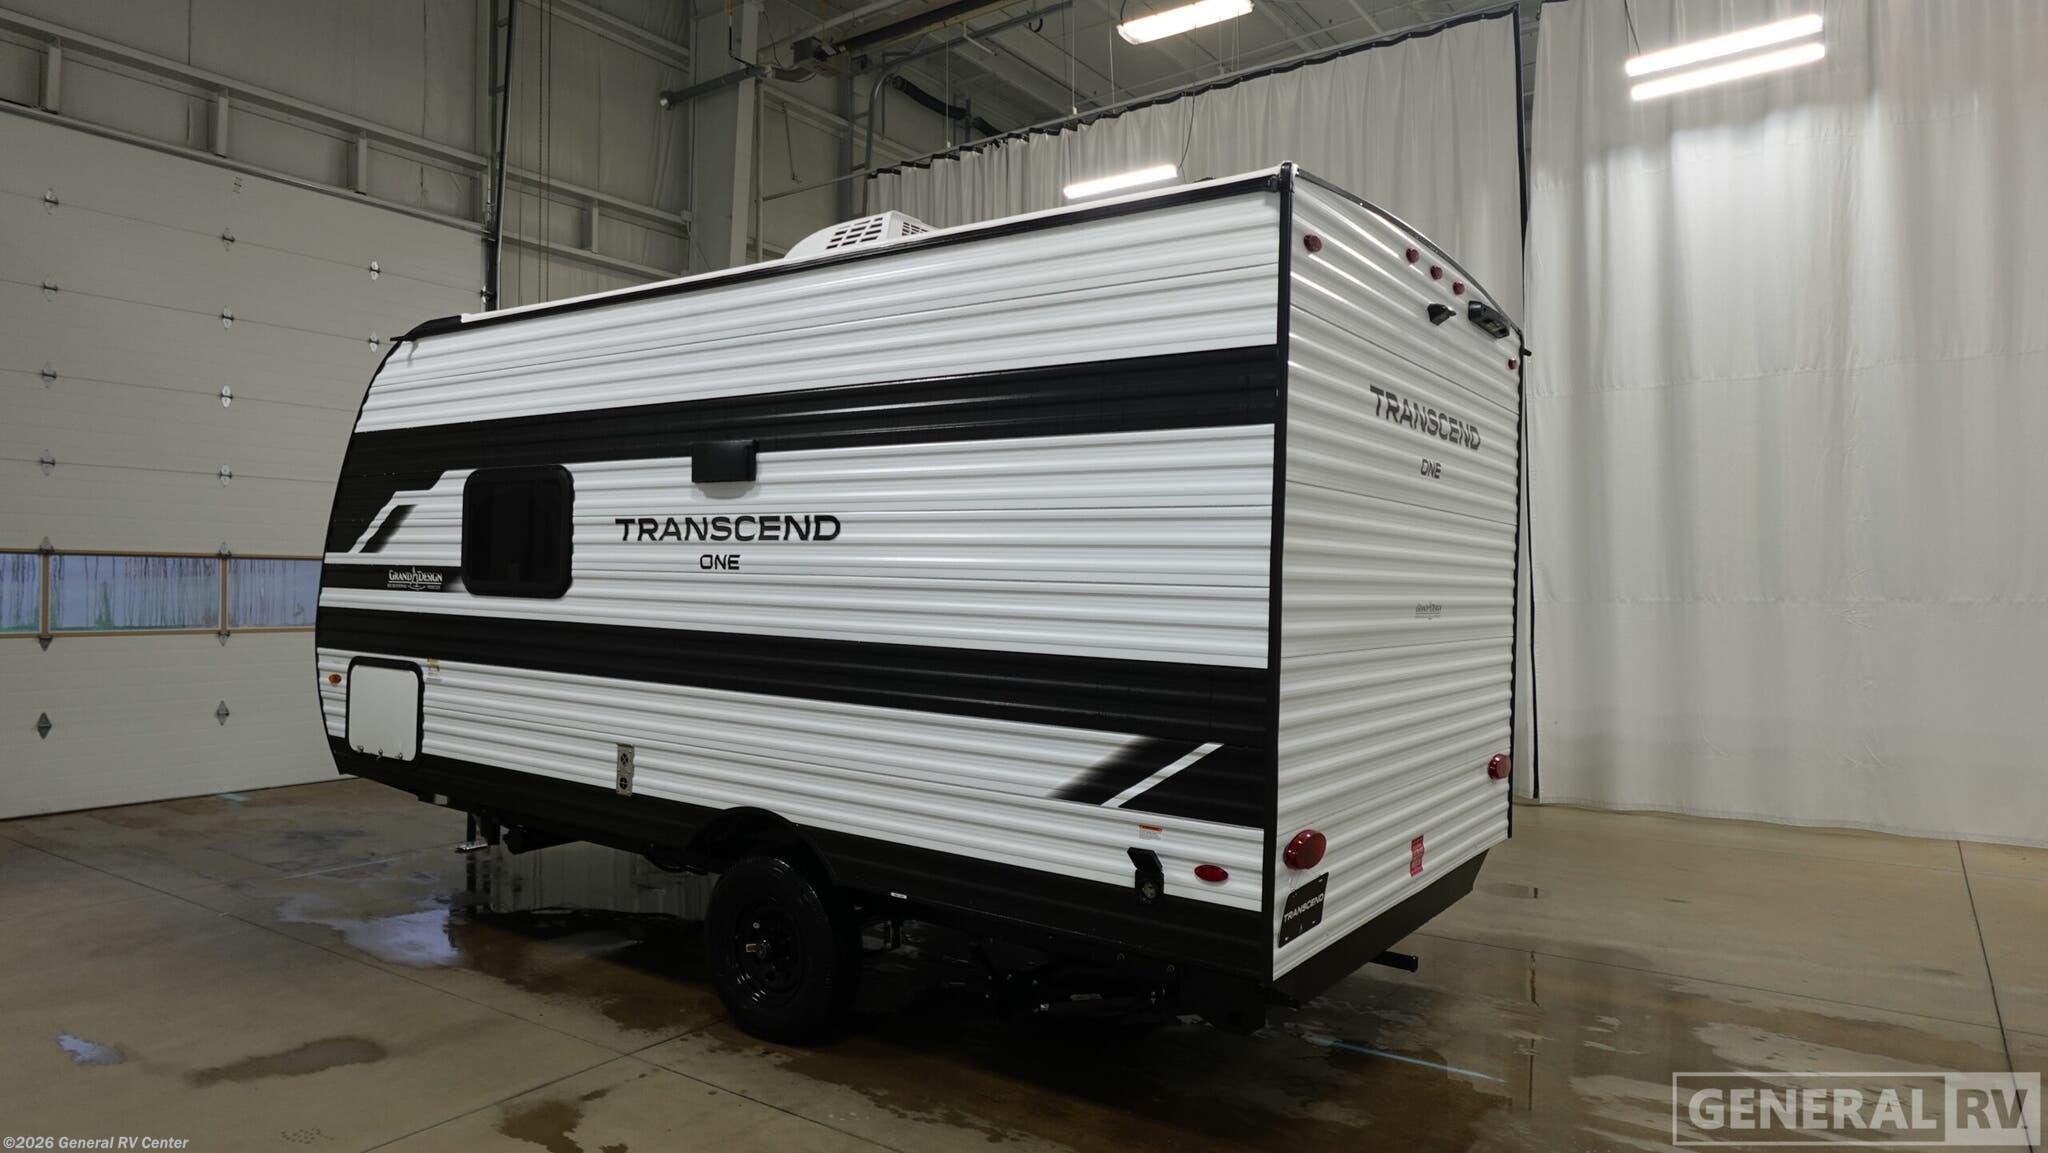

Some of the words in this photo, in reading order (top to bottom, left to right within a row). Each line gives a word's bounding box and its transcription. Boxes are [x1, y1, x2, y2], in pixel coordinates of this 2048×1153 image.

[1370, 384, 1480, 450] TRANSCEND
[1420, 458, 1441, 479] ONE
[615, 515, 841, 542] TRANSCEND
[700, 554, 740, 570] ONE
